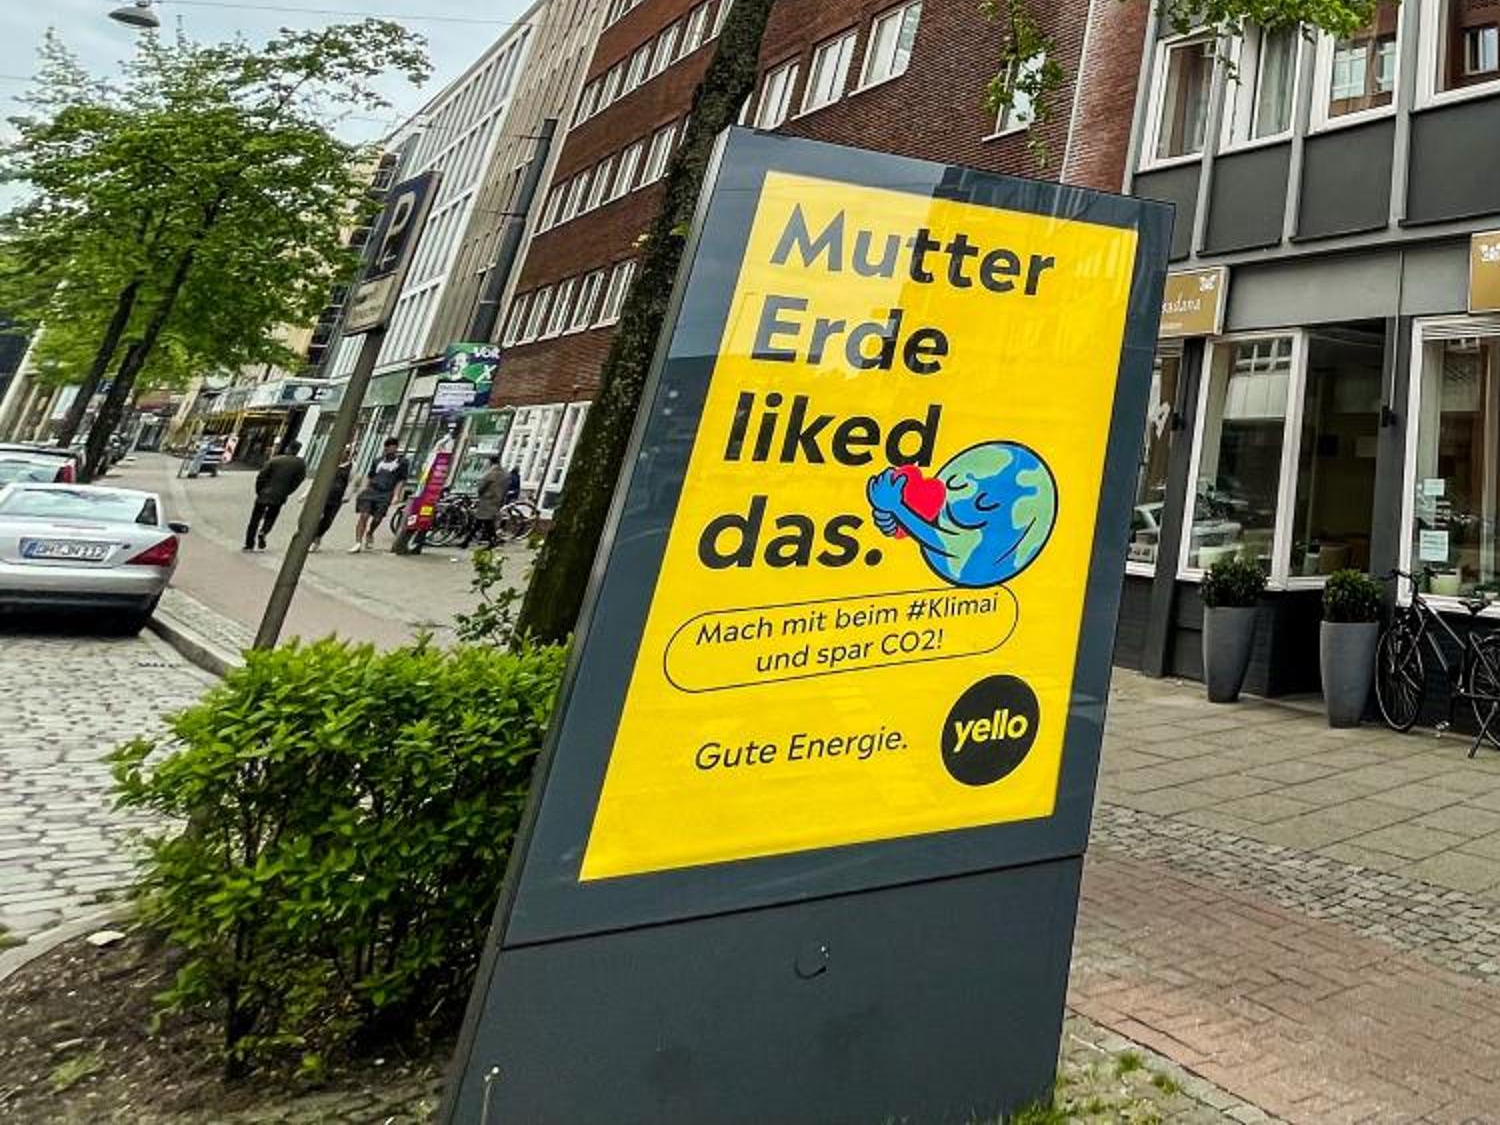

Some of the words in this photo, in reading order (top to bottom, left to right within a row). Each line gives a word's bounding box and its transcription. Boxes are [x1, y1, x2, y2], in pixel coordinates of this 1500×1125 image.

[377, 191, 417, 266] P
[770, 203, 1055, 295] Mutter
[751, 295, 949, 375] Erde
[723, 391, 942, 468] liked
[697, 495, 883, 569] das.
[696, 617, 772, 645] Mach
[782, 611, 826, 635] mit
[836, 605, 898, 629] beim
[756, 646, 808, 673] und
[817, 640, 873, 667] spar
[881, 628, 943, 655] CO2!
[695, 741, 777, 770] Gute
[788, 726, 908, 763] Energie.
[953, 709, 1029, 752] yello
